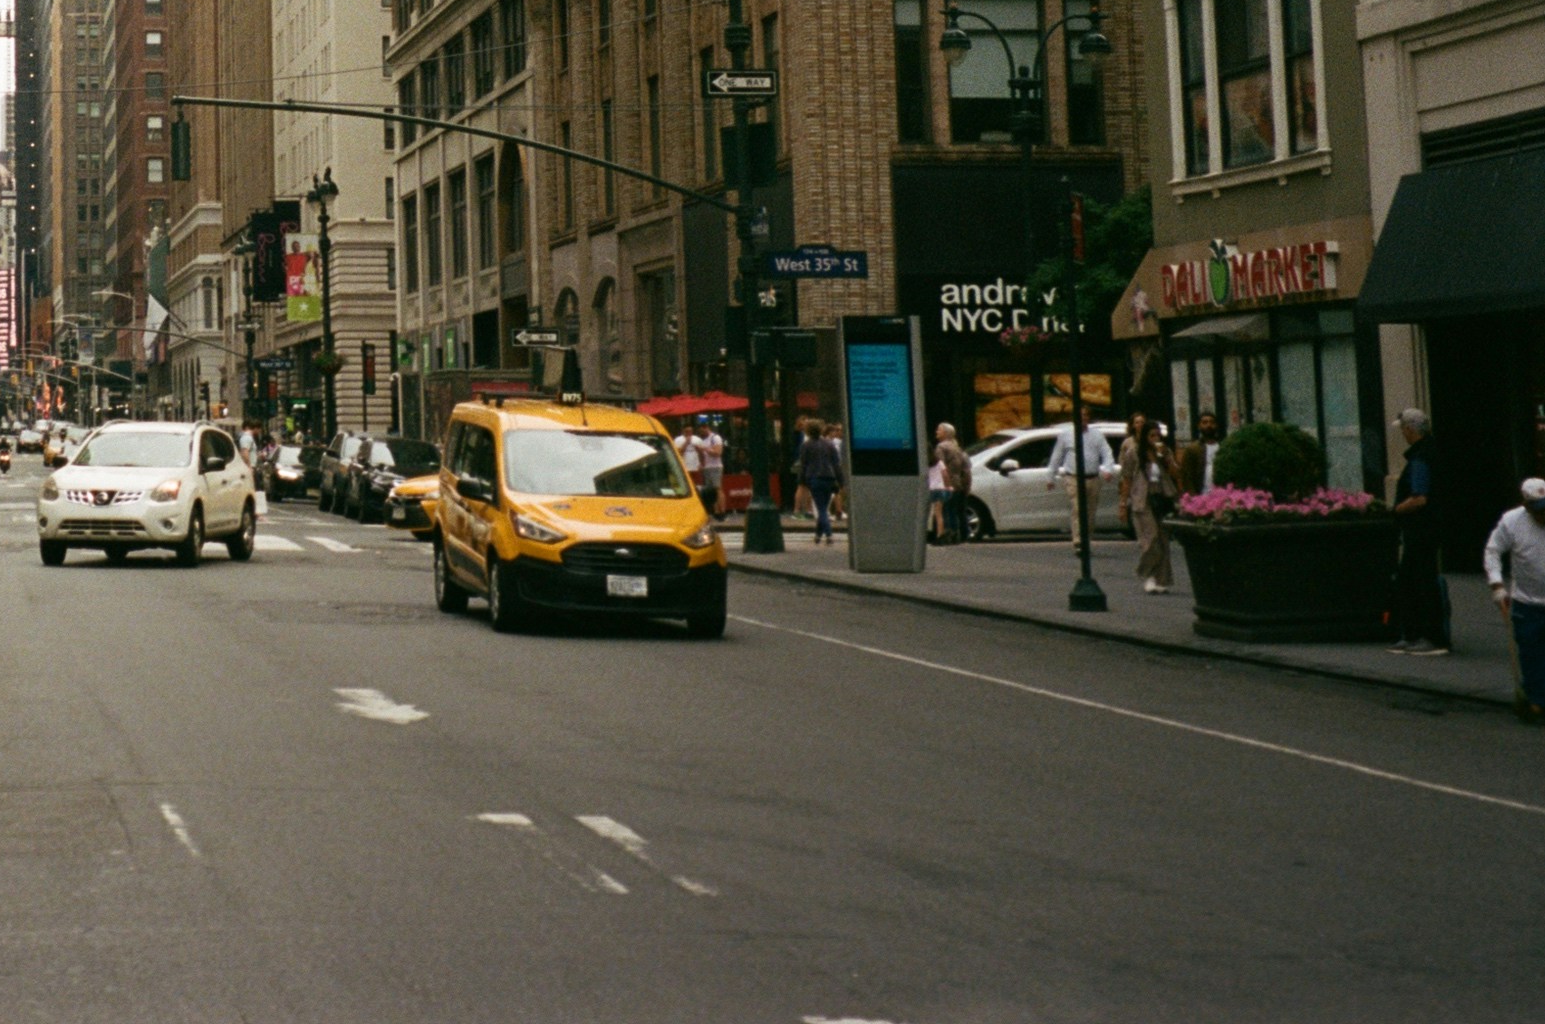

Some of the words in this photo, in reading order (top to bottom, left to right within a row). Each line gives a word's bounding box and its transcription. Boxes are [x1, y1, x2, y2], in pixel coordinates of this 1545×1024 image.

[718, 78, 735, 87] ONE
[775, 258, 811, 272] West
[815, 258, 840, 272] 35th
[844, 258, 858, 272] St
[1161, 259, 1208, 311] DALI
[1230, 240, 1328, 302] MARKET
[941, 308, 1003, 332] NYC
